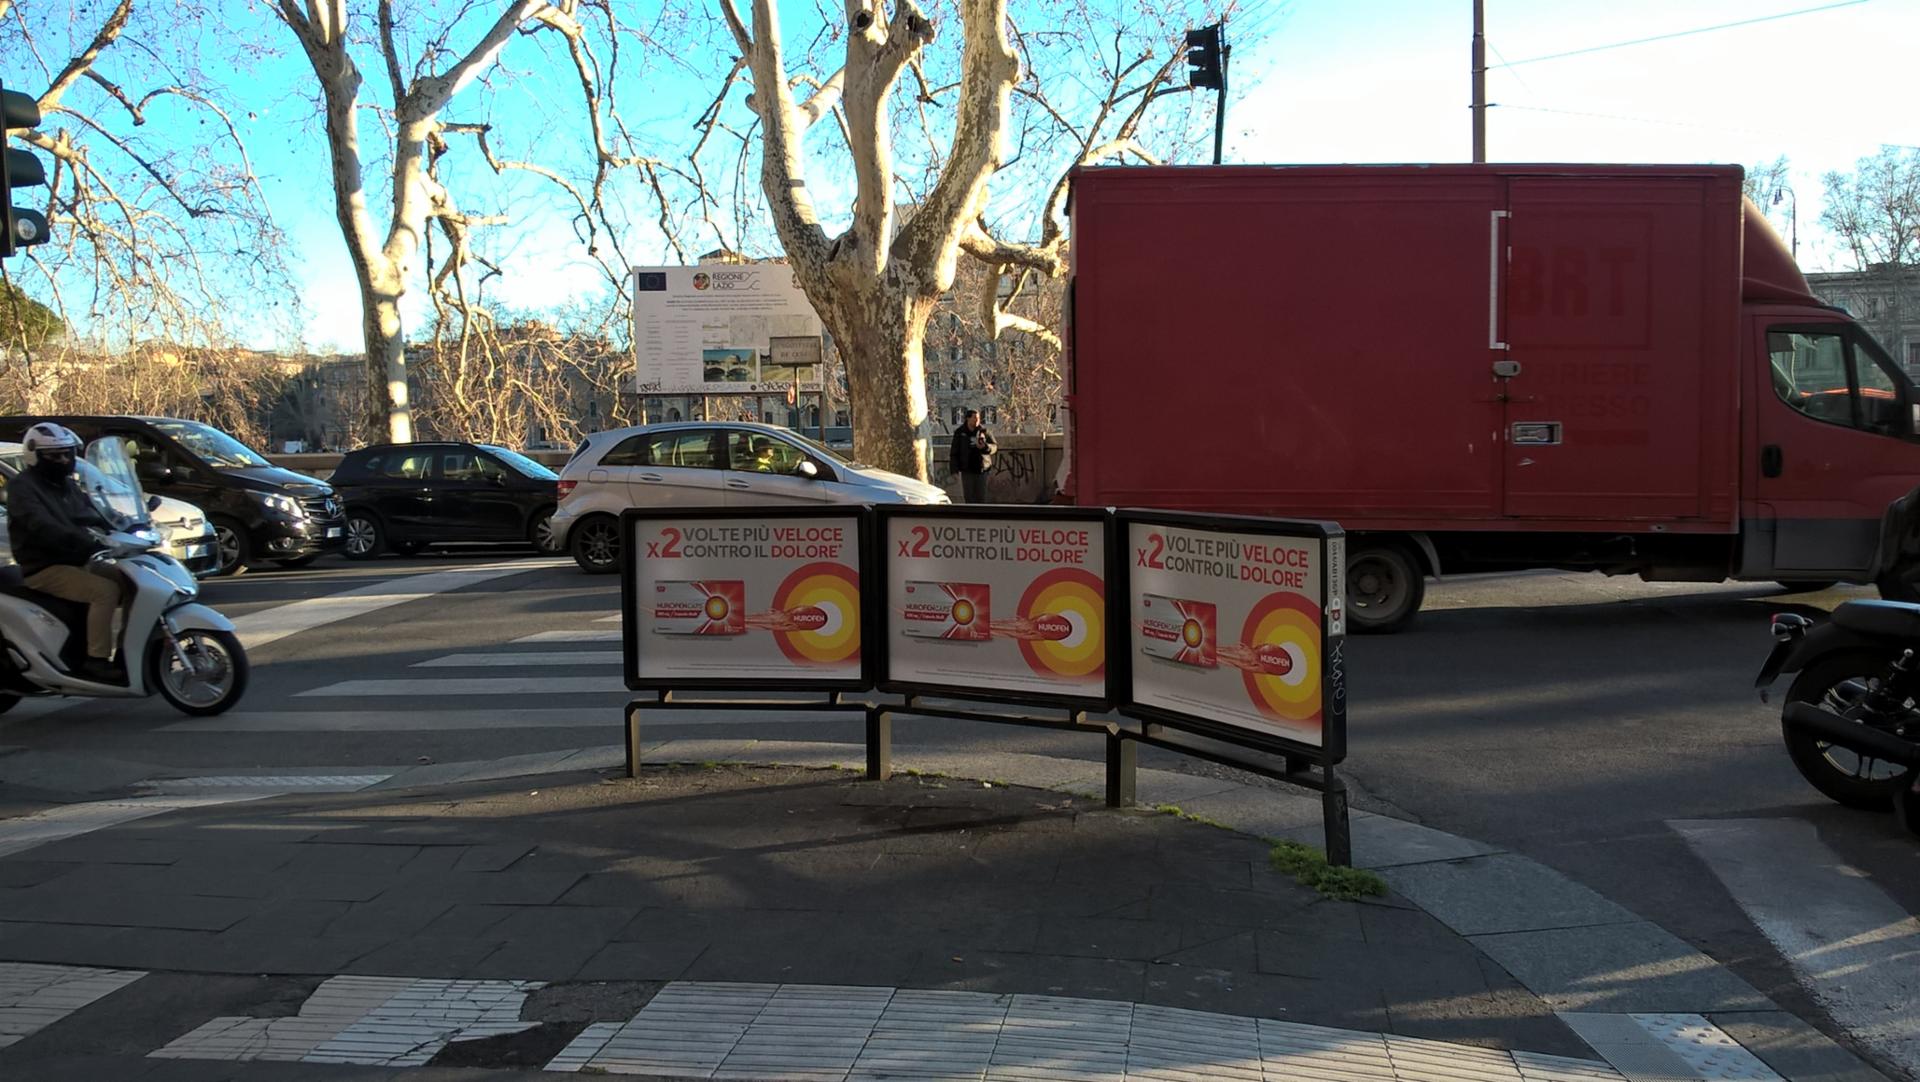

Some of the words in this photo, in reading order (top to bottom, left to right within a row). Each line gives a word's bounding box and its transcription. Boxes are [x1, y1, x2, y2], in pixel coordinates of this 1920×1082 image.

[713, 272, 745, 281] REGIONE
[713, 282, 735, 290] LAZIO
[683, 527, 740, 542] VOLTE
[743, 524, 770, 542] PIÙ
[773, 527, 844, 542] VELOCE
[931, 526, 987, 543] VOLTE
[989, 525, 1016, 544] PIÙ
[1019, 528, 1089, 546] VELOCE
[682, 544, 752, 559] CONTRO
[755, 545, 768, 558] IL
[931, 544, 998, 561] CONTRO
[1000, 546, 1014, 561] IL
[1165, 534, 1214, 557] VOLTE
[1216, 539, 1240, 560] PIÙ
[1242, 543, 1309, 569] VELOCE
[1164, 555, 1224, 578] CONTRO
[1226, 562, 1239, 580] IL
[1038, 623, 1071, 632] NUROFEN
[1260, 654, 1291, 667] NUROFEN
